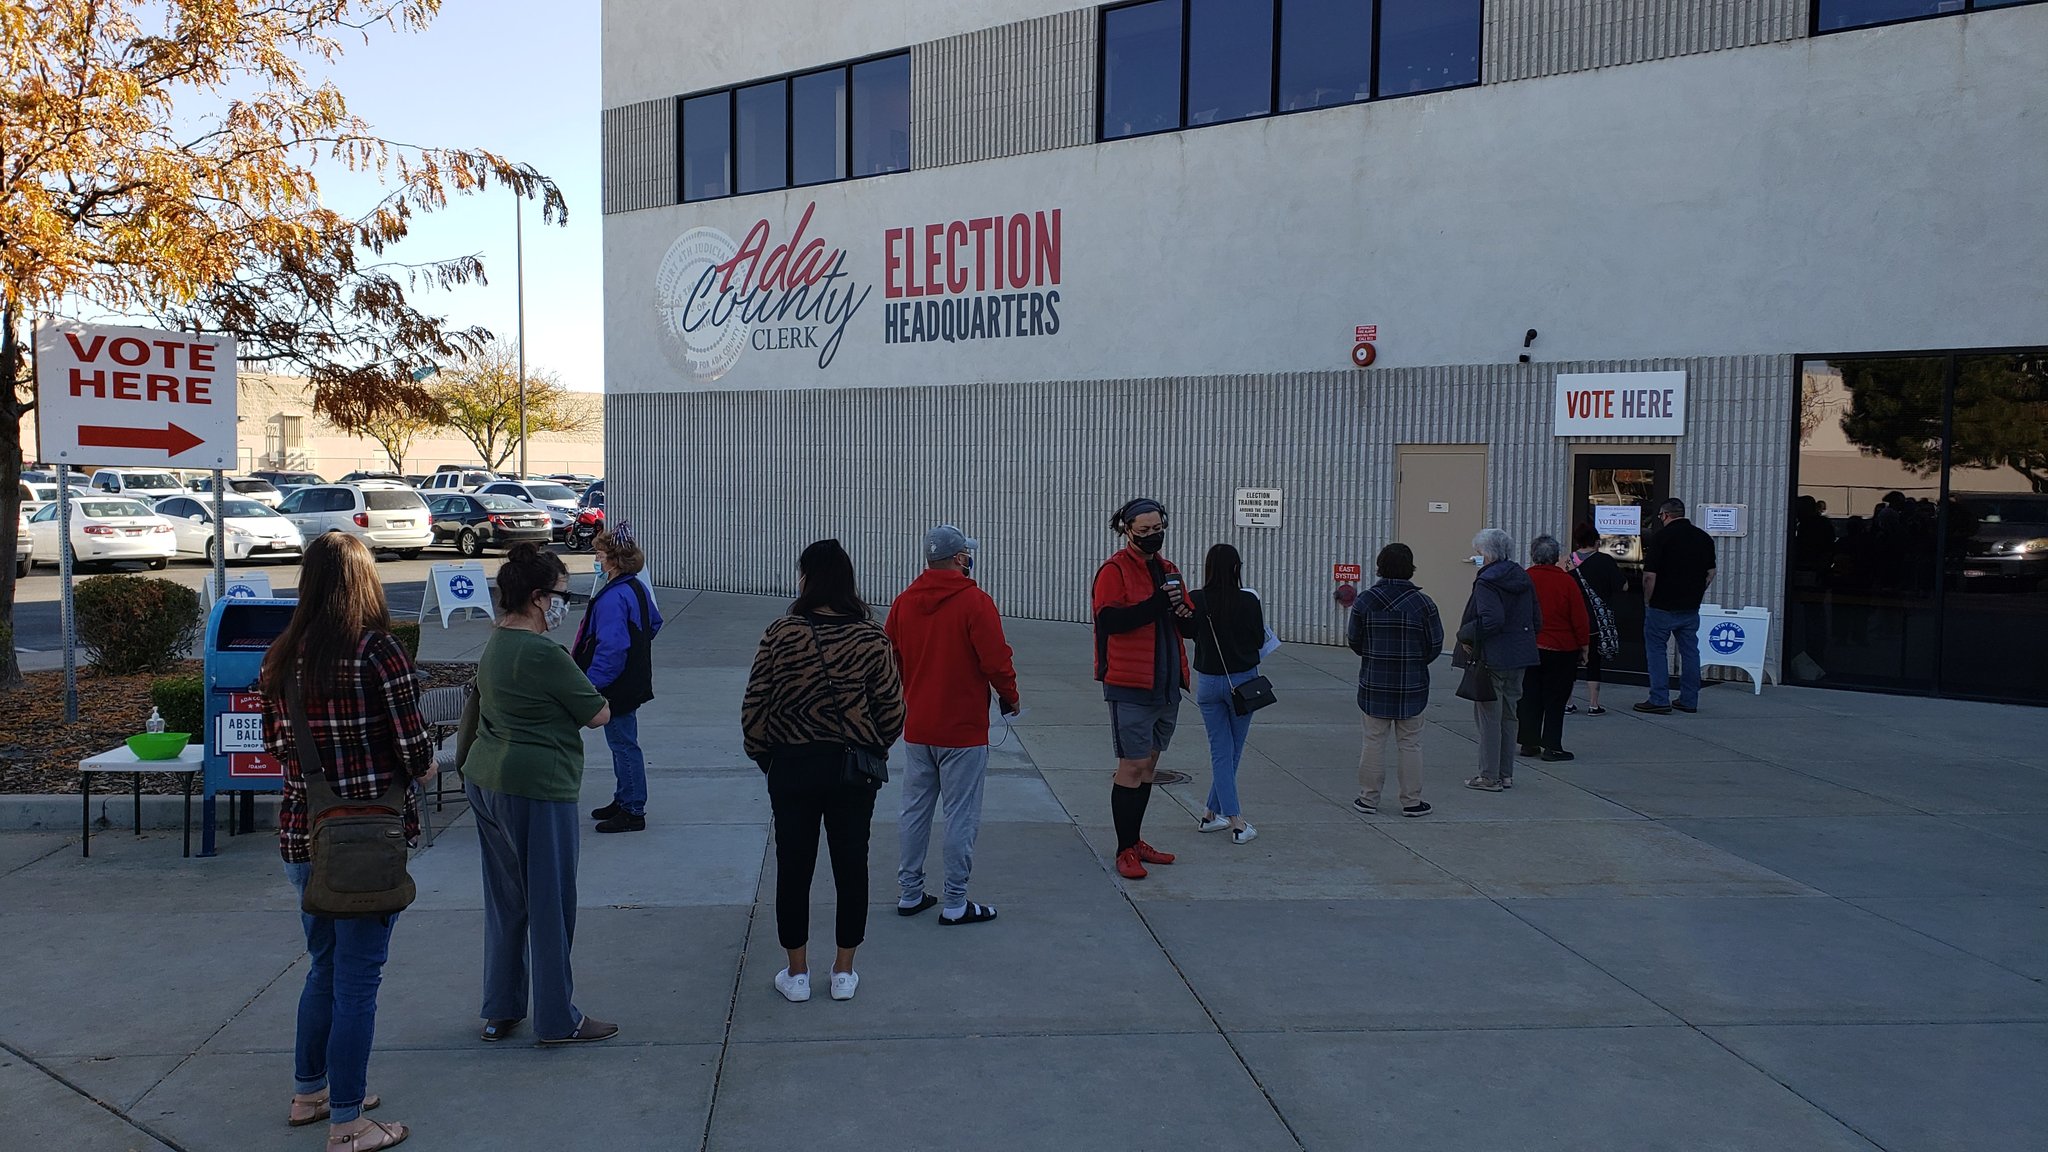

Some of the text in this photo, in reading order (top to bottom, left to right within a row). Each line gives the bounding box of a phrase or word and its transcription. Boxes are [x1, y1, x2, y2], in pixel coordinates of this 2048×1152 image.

[715, 201, 839, 297] Ada
[884, 208, 1062, 299] ELECTION
[682, 250, 873, 370] County
[884, 290, 1062, 344] HEADQUARTERS
[64, 333, 216, 372] VOTE
[752, 322, 818, 351] CLERK
[69, 368, 212, 405] HERE
[1566, 389, 1674, 419] VOTE HERE
